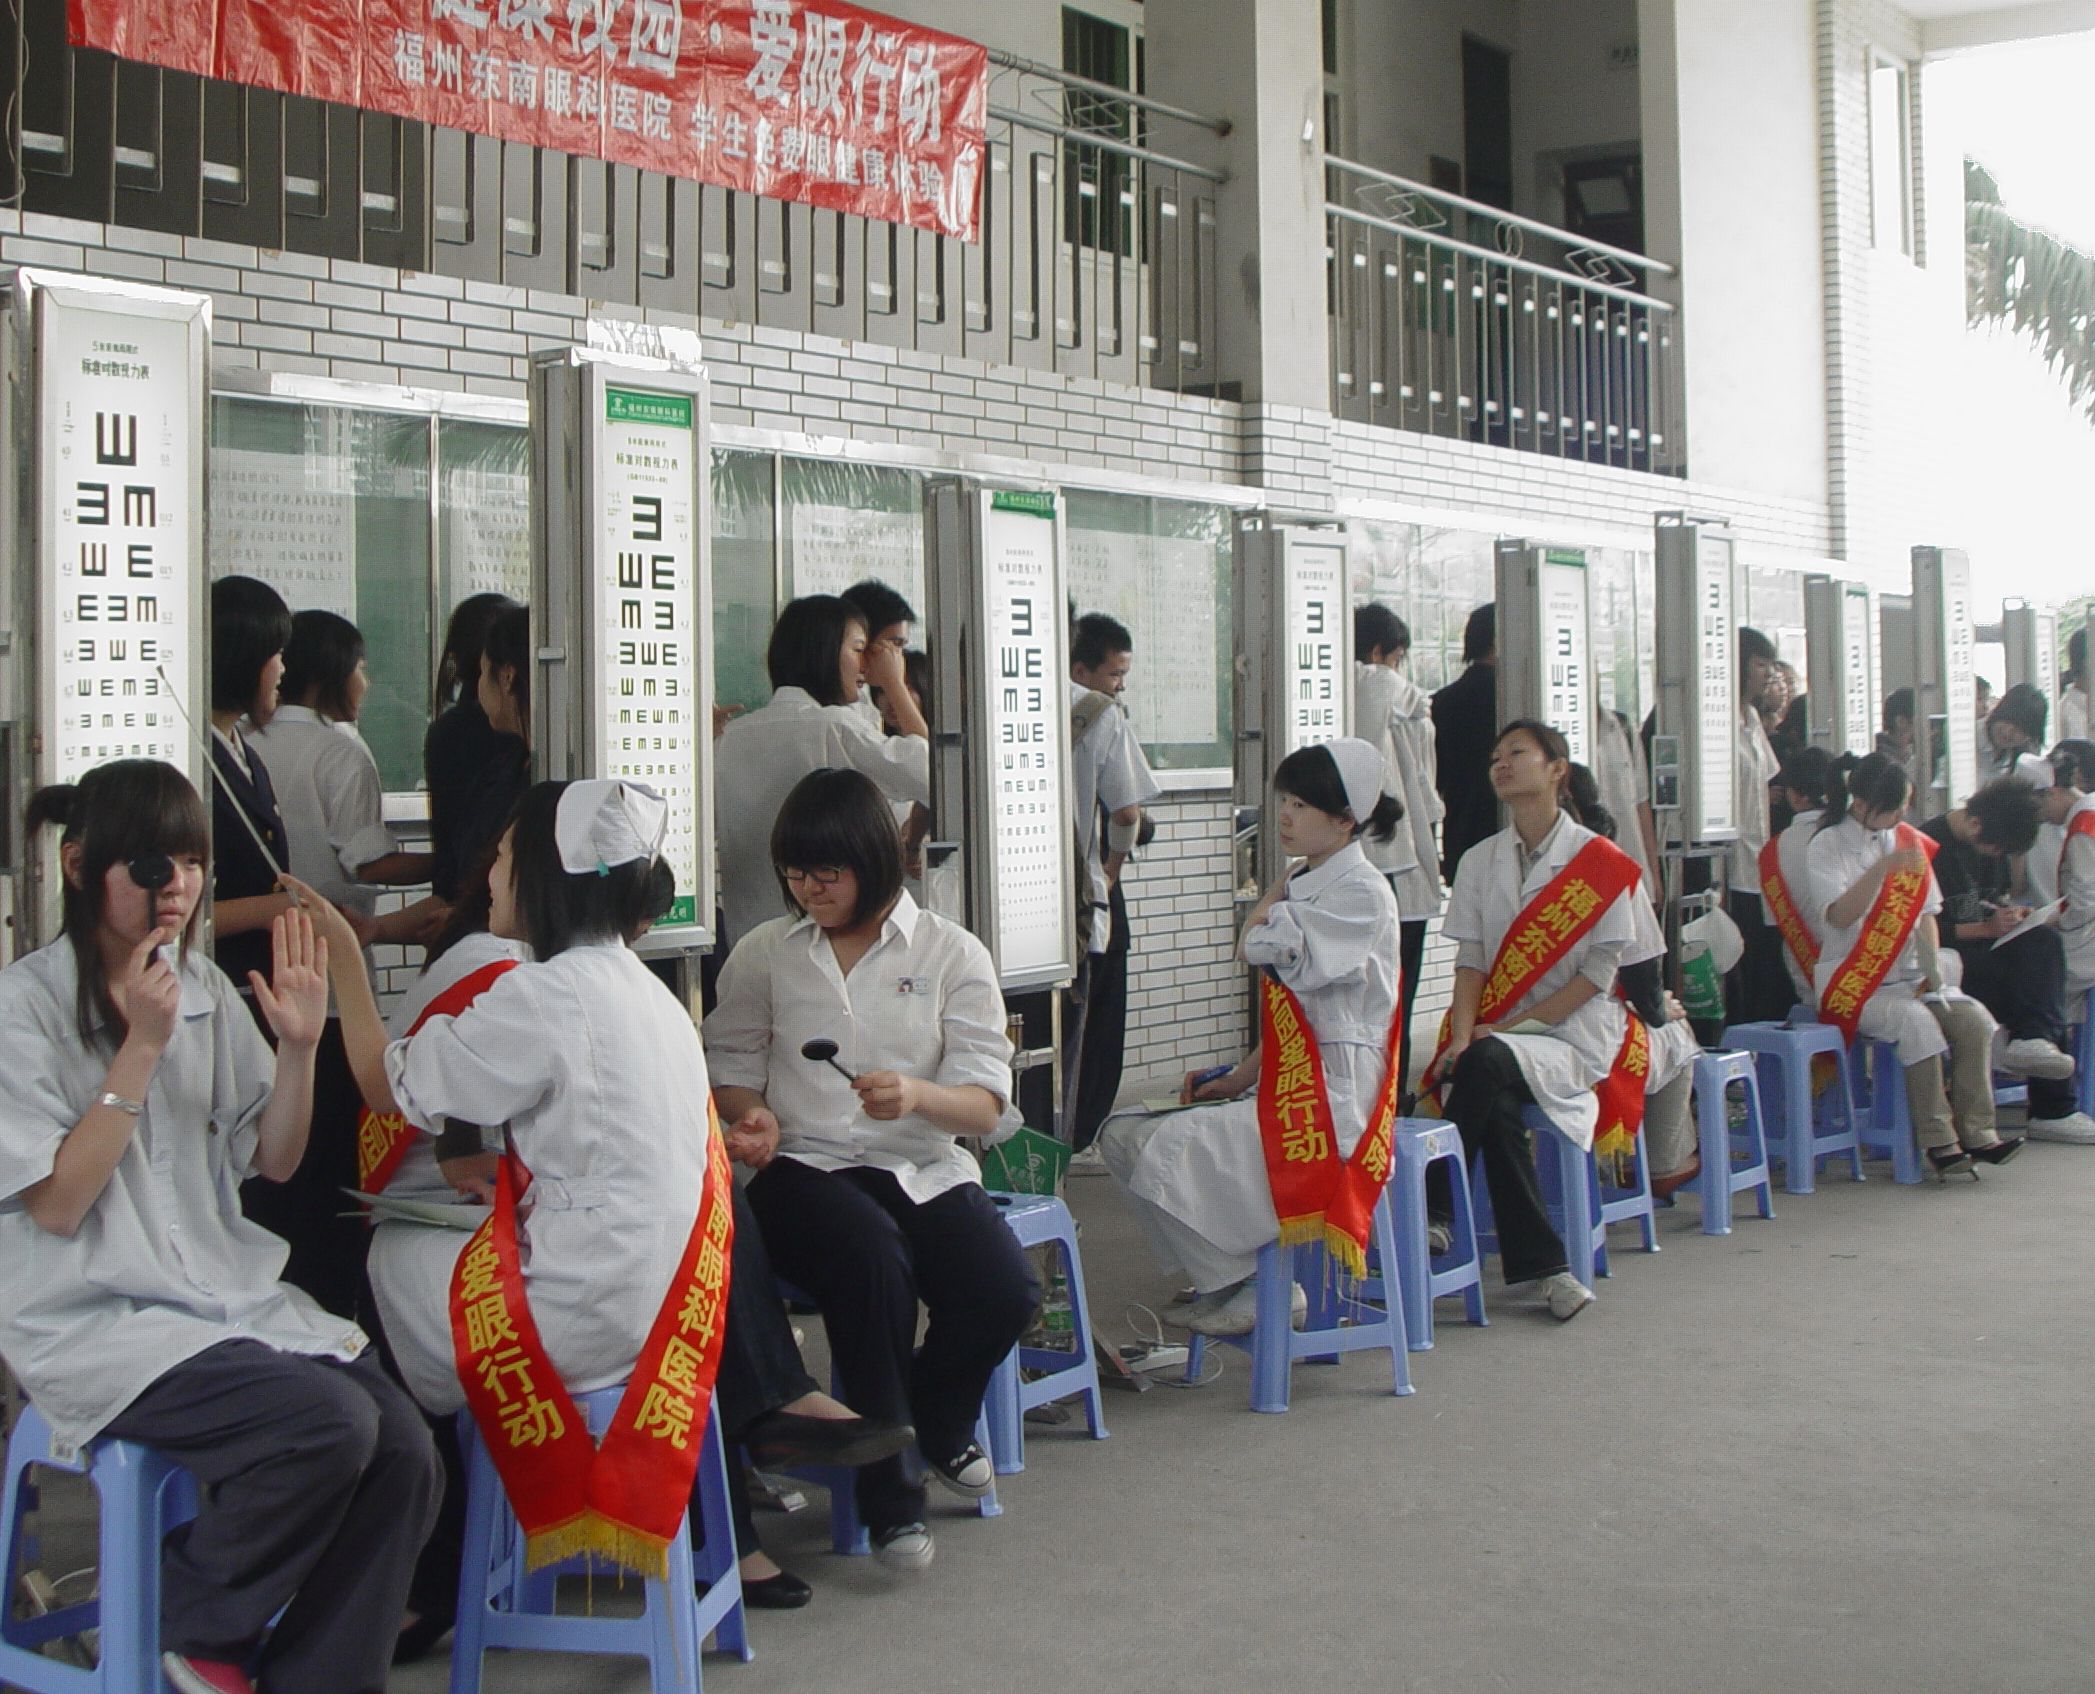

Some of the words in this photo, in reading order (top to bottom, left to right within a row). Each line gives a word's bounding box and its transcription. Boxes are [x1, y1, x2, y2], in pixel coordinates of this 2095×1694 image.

[393, 27, 672, 142] 福州东南眼科医院
[691, 98, 946, 203] 学生免费眼健康体验
[433, 0, 942, 147] 校园·爱眼行动
[1265, 974, 1329, 1164] 园爱眼行动
